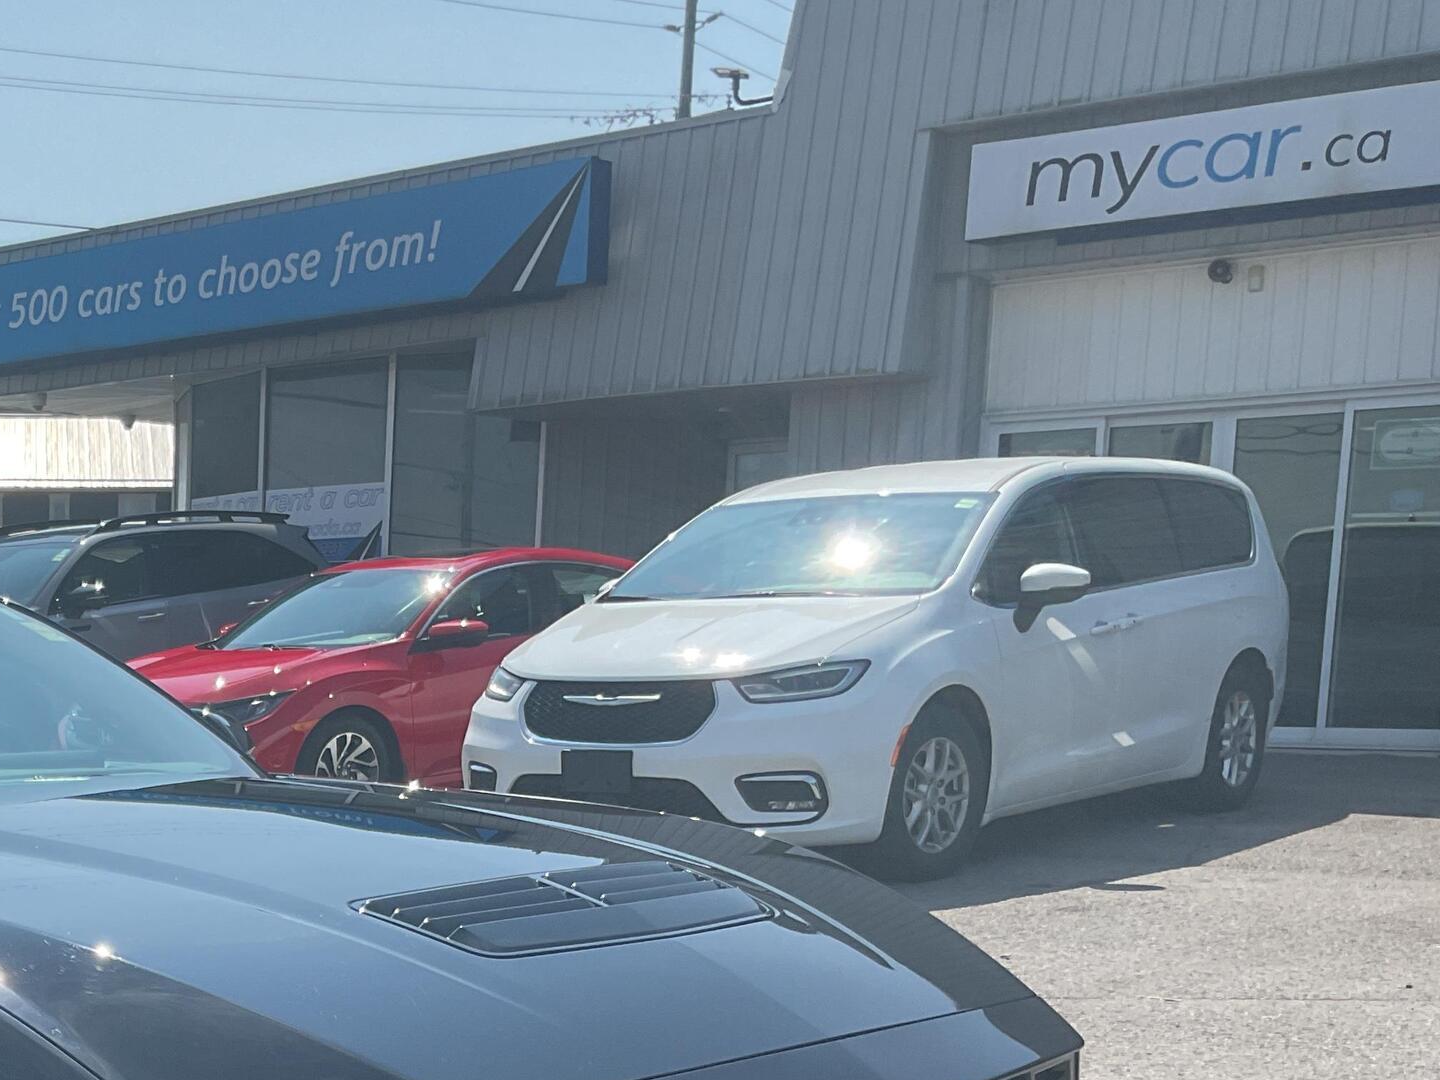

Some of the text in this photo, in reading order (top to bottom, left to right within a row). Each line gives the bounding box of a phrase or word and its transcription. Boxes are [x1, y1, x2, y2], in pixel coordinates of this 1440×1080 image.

[1025, 124, 1392, 215] mycar.ca
[8, 285, 68, 329] 500
[77, 280, 143, 318] cars
[154, 268, 187, 306] to
[198, 255, 321, 299] choose
[329, 219, 442, 288] from!
[268, 484, 314, 512] rent
[320, 490, 338, 510] a
[344, 487, 385, 509] car
